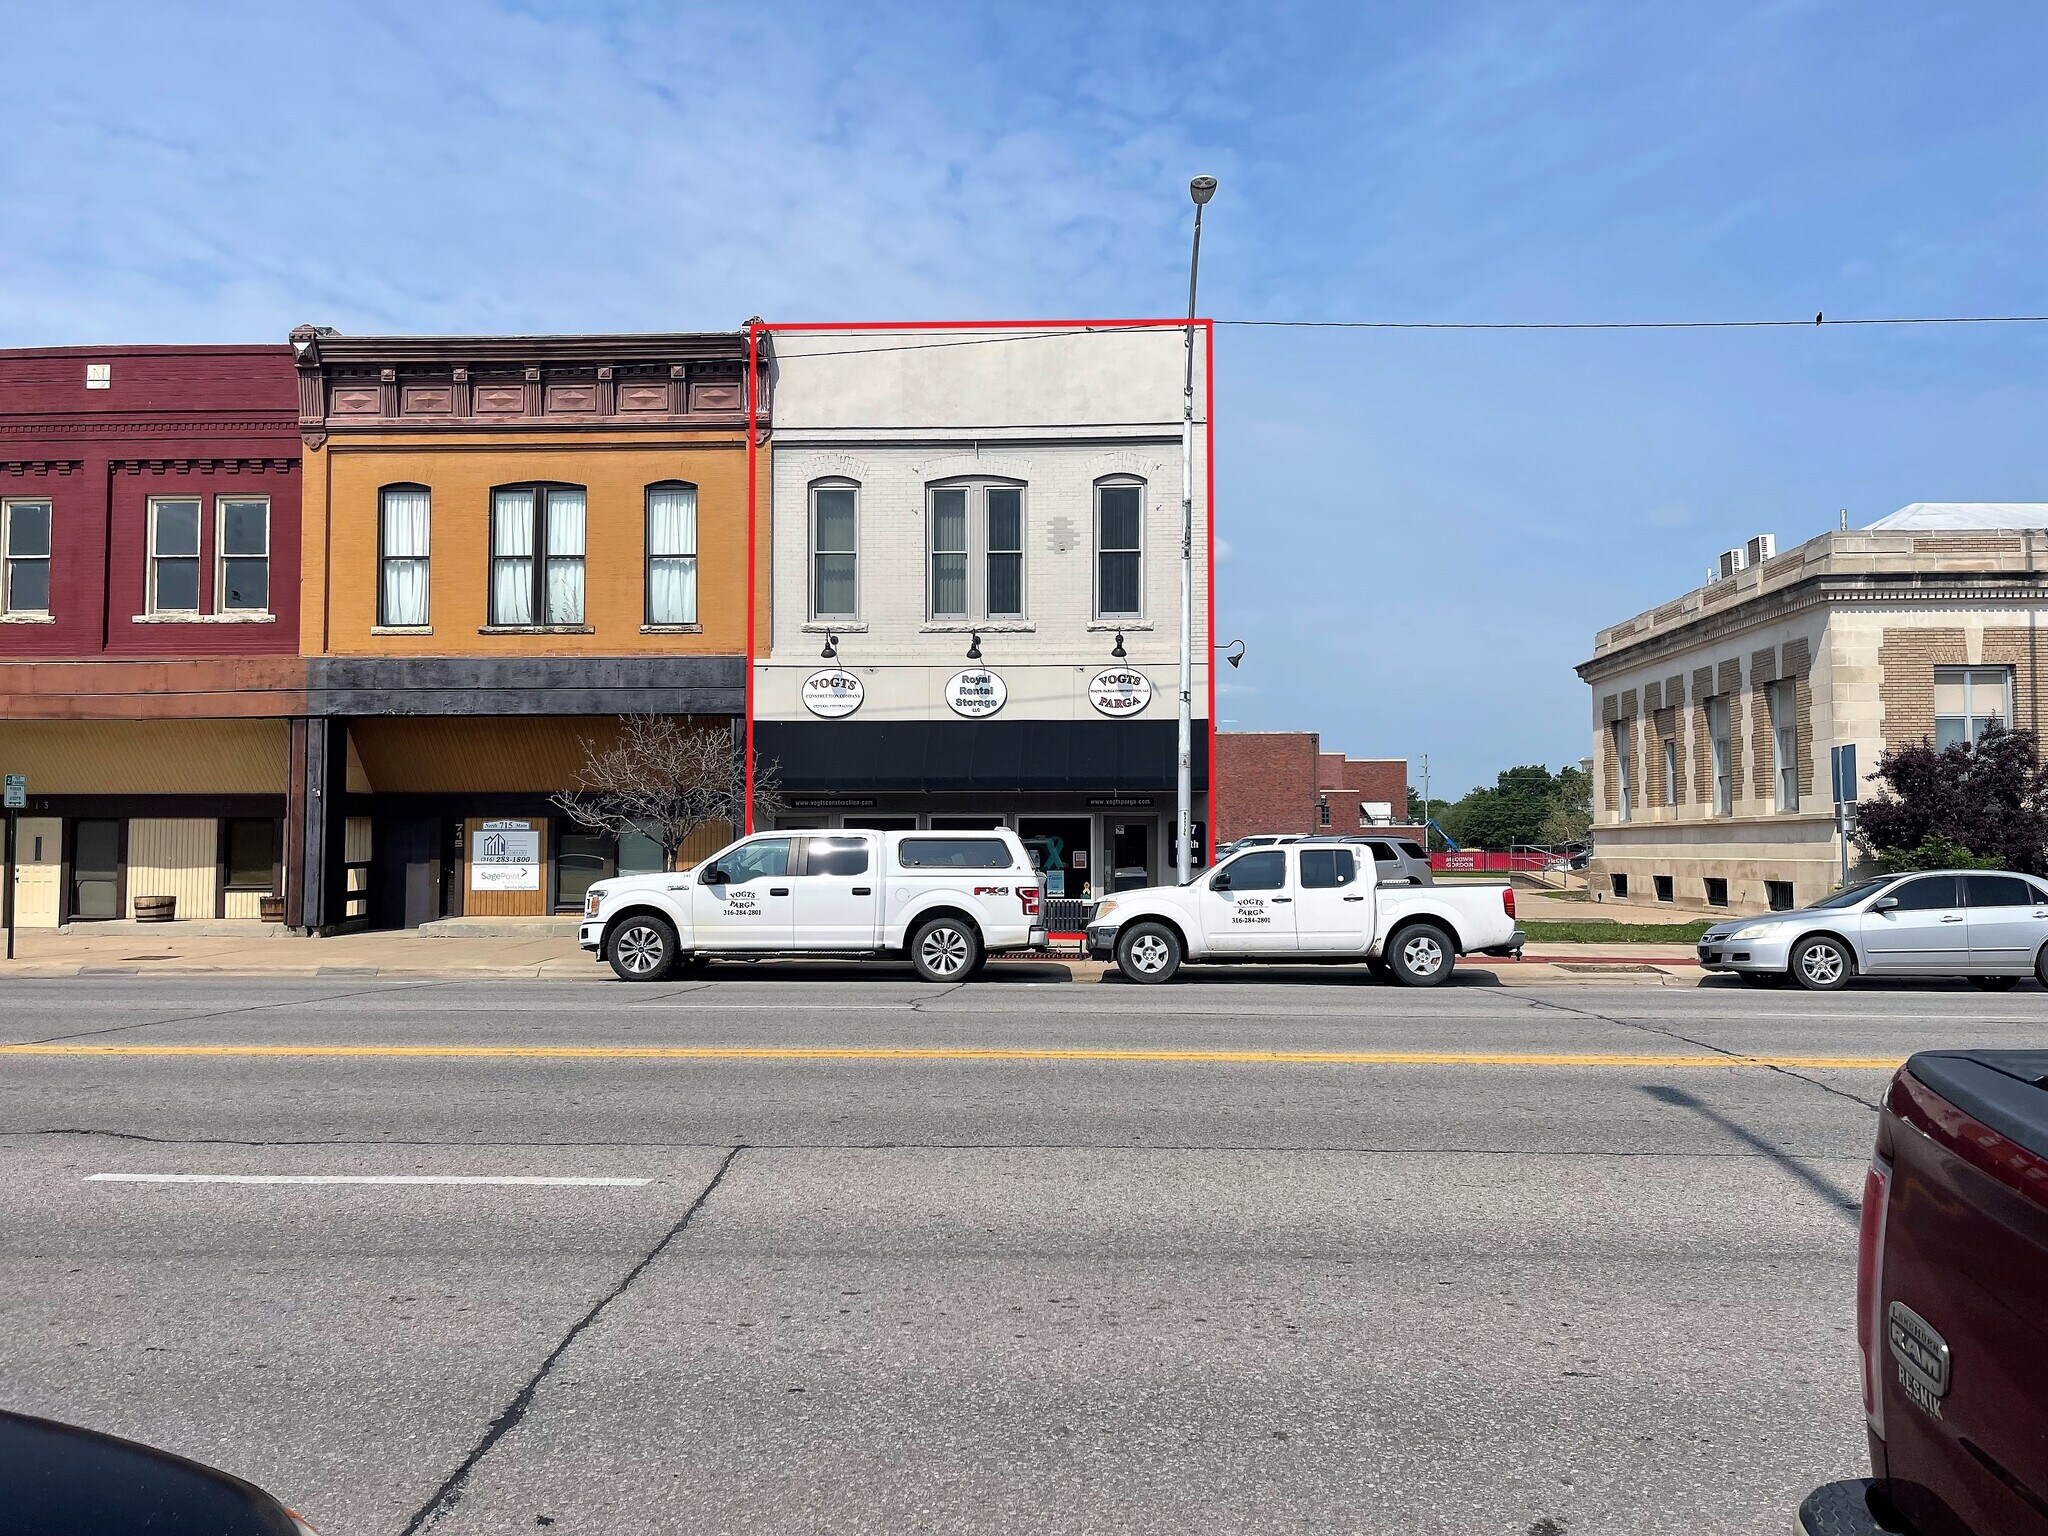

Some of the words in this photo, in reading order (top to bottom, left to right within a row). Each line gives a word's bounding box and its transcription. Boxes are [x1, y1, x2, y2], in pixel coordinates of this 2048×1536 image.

[809, 677, 857, 691] VOGTS
[962, 675, 991, 685] Royal
[1098, 674, 1141, 686] VOGTS
[960, 686, 994, 695] Rental
[955, 698, 998, 709] Storage
[1098, 696, 1141, 708] PARGA
[499, 821, 513, 829] 715
[480, 871, 521, 881] SagePoint
[974, 887, 1009, 895] FX4
[729, 900, 755, 909] PARGA
[1237, 898, 1264, 906] VOGTS
[1237, 908, 1264, 916] PARGA
[1892, 1321, 1940, 1381] RAM
[1898, 1363, 1944, 1420] RESNIK
